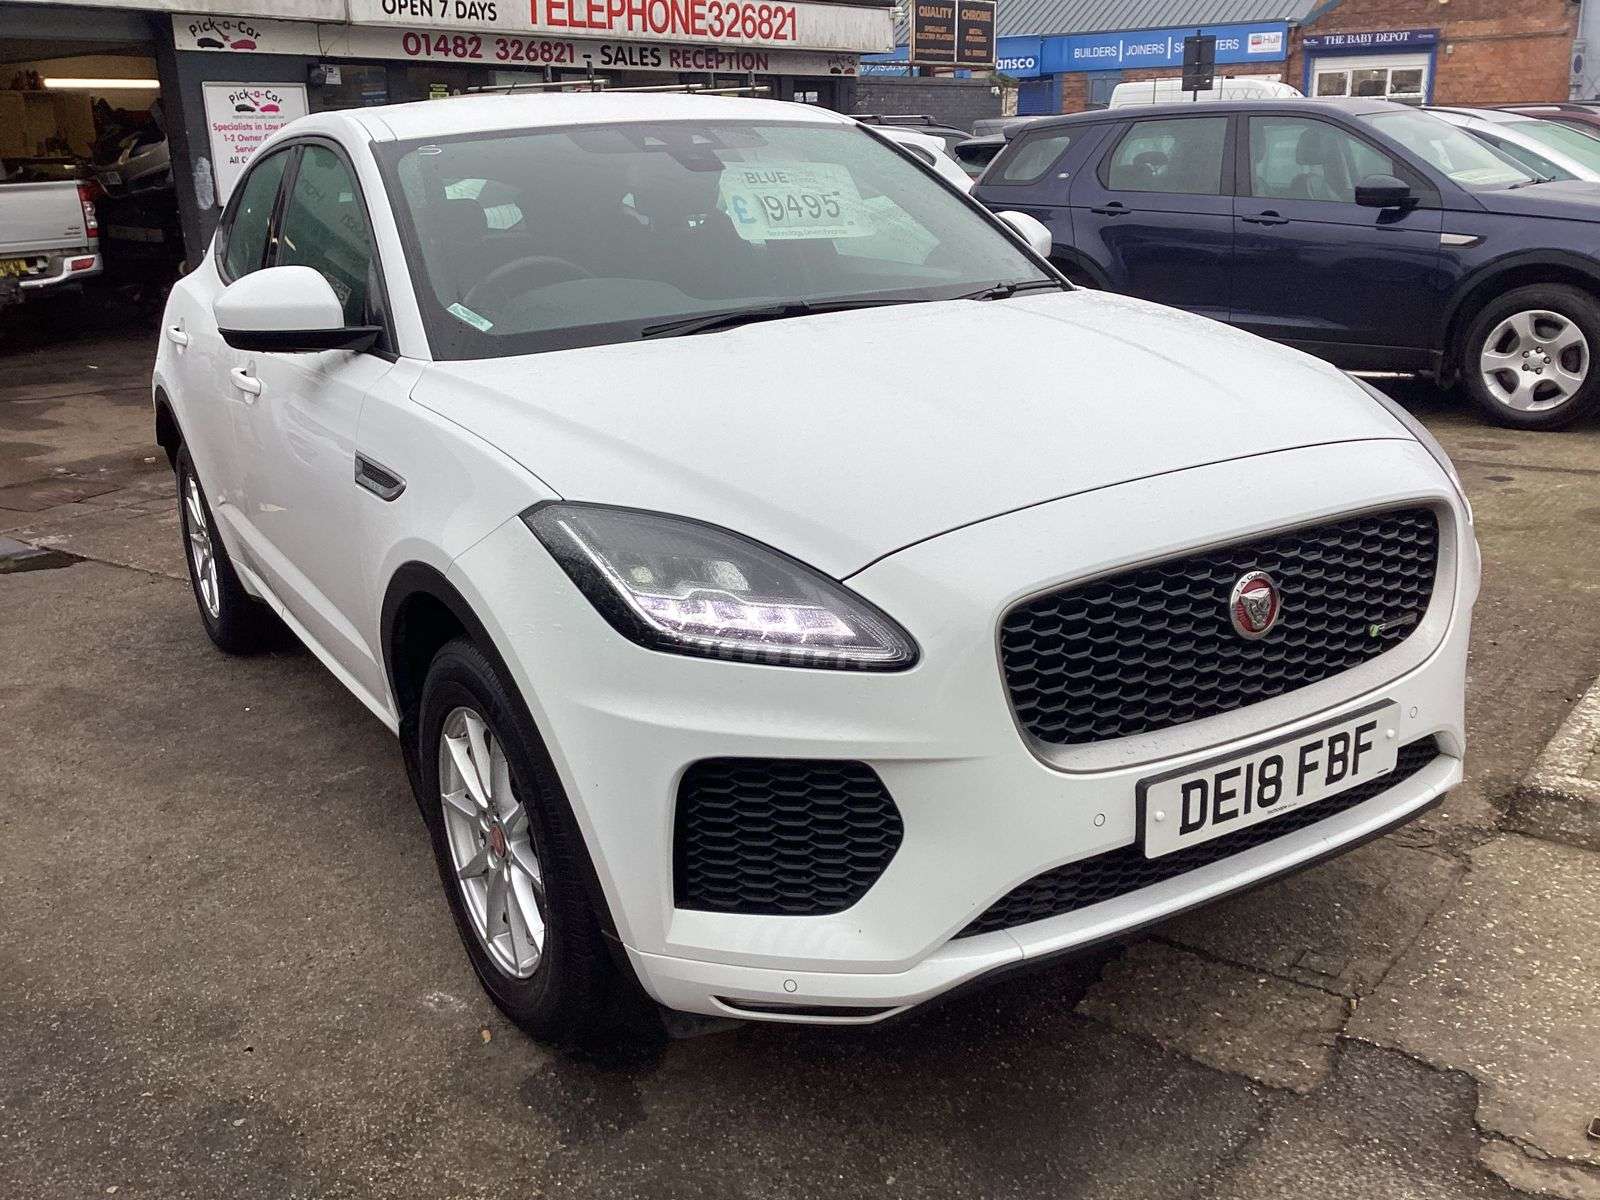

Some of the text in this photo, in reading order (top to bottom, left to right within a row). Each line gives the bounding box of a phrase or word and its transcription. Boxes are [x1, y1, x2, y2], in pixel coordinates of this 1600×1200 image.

[382, 0, 497, 21] OPEN 7 DAYS
[918, 5, 953, 19] QUALITY
[188, 17, 262, 40] Pick-a-Car
[1324, 35, 1345, 45] THE
[1347, 34, 1374, 44] BABY
[1376, 31, 1411, 42] DEPOT
[402, 31, 483, 59] 01482
[495, 37, 575, 64] 326821
[600, 44, 662, 68] SALES
[670, 49, 769, 72] RECEPTION
[1073, 46, 1117, 58] BUILDERS
[1126, 44, 1165, 56] JOINERS
[228, 88, 283, 105] Pick-a-Car
[213, 122, 253, 132] Specialists
[255, 123, 263, 131] in
[265, 123, 279, 131] Low
[224, 134, 235, 142] 1-2
[238, 134, 262, 142] Owner
[229, 156, 240, 164] All
[744, 171, 790, 185] BLUE
[1179, 719, 1378, 836] DE18 FBF
